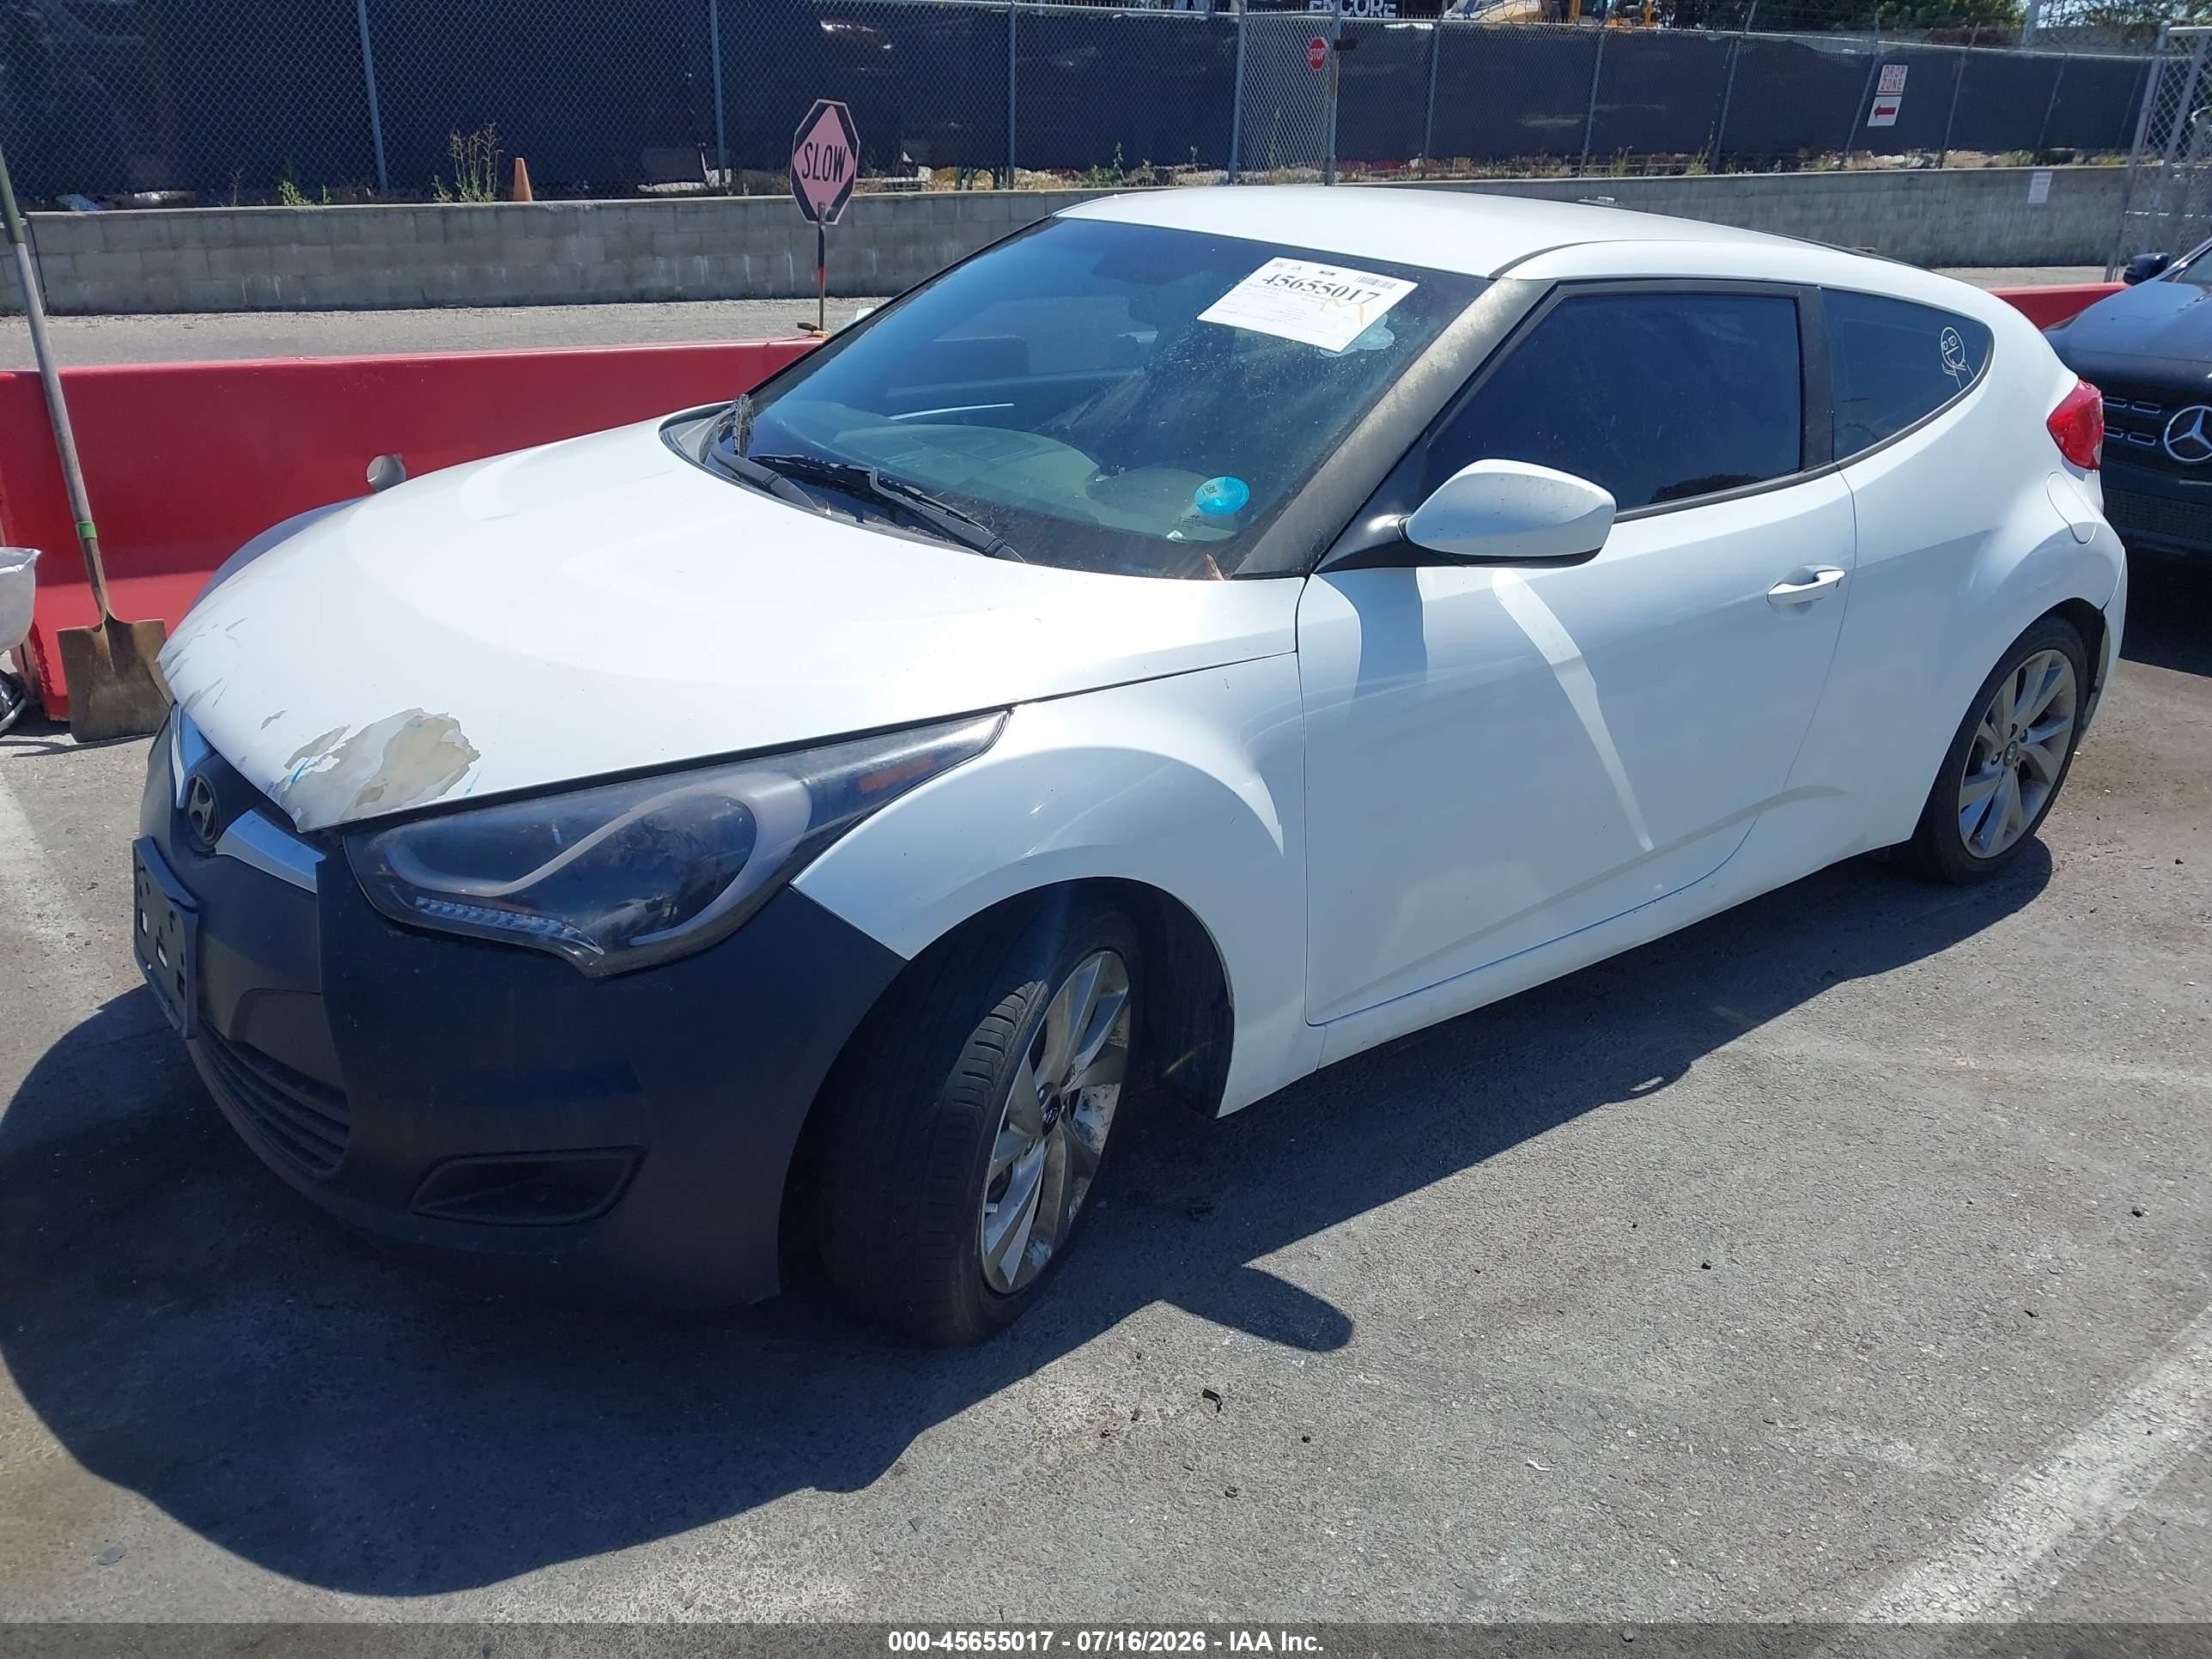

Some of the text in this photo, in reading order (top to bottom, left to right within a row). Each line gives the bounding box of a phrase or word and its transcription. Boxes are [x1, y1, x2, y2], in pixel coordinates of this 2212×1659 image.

[1309, 47, 1325, 61] STOP
[1883, 65, 1905, 77] DROP
[1881, 78, 1903, 90] ZONE
[801, 141, 848, 183] SLOW
[1261, 273, 1382, 304] 45655017
